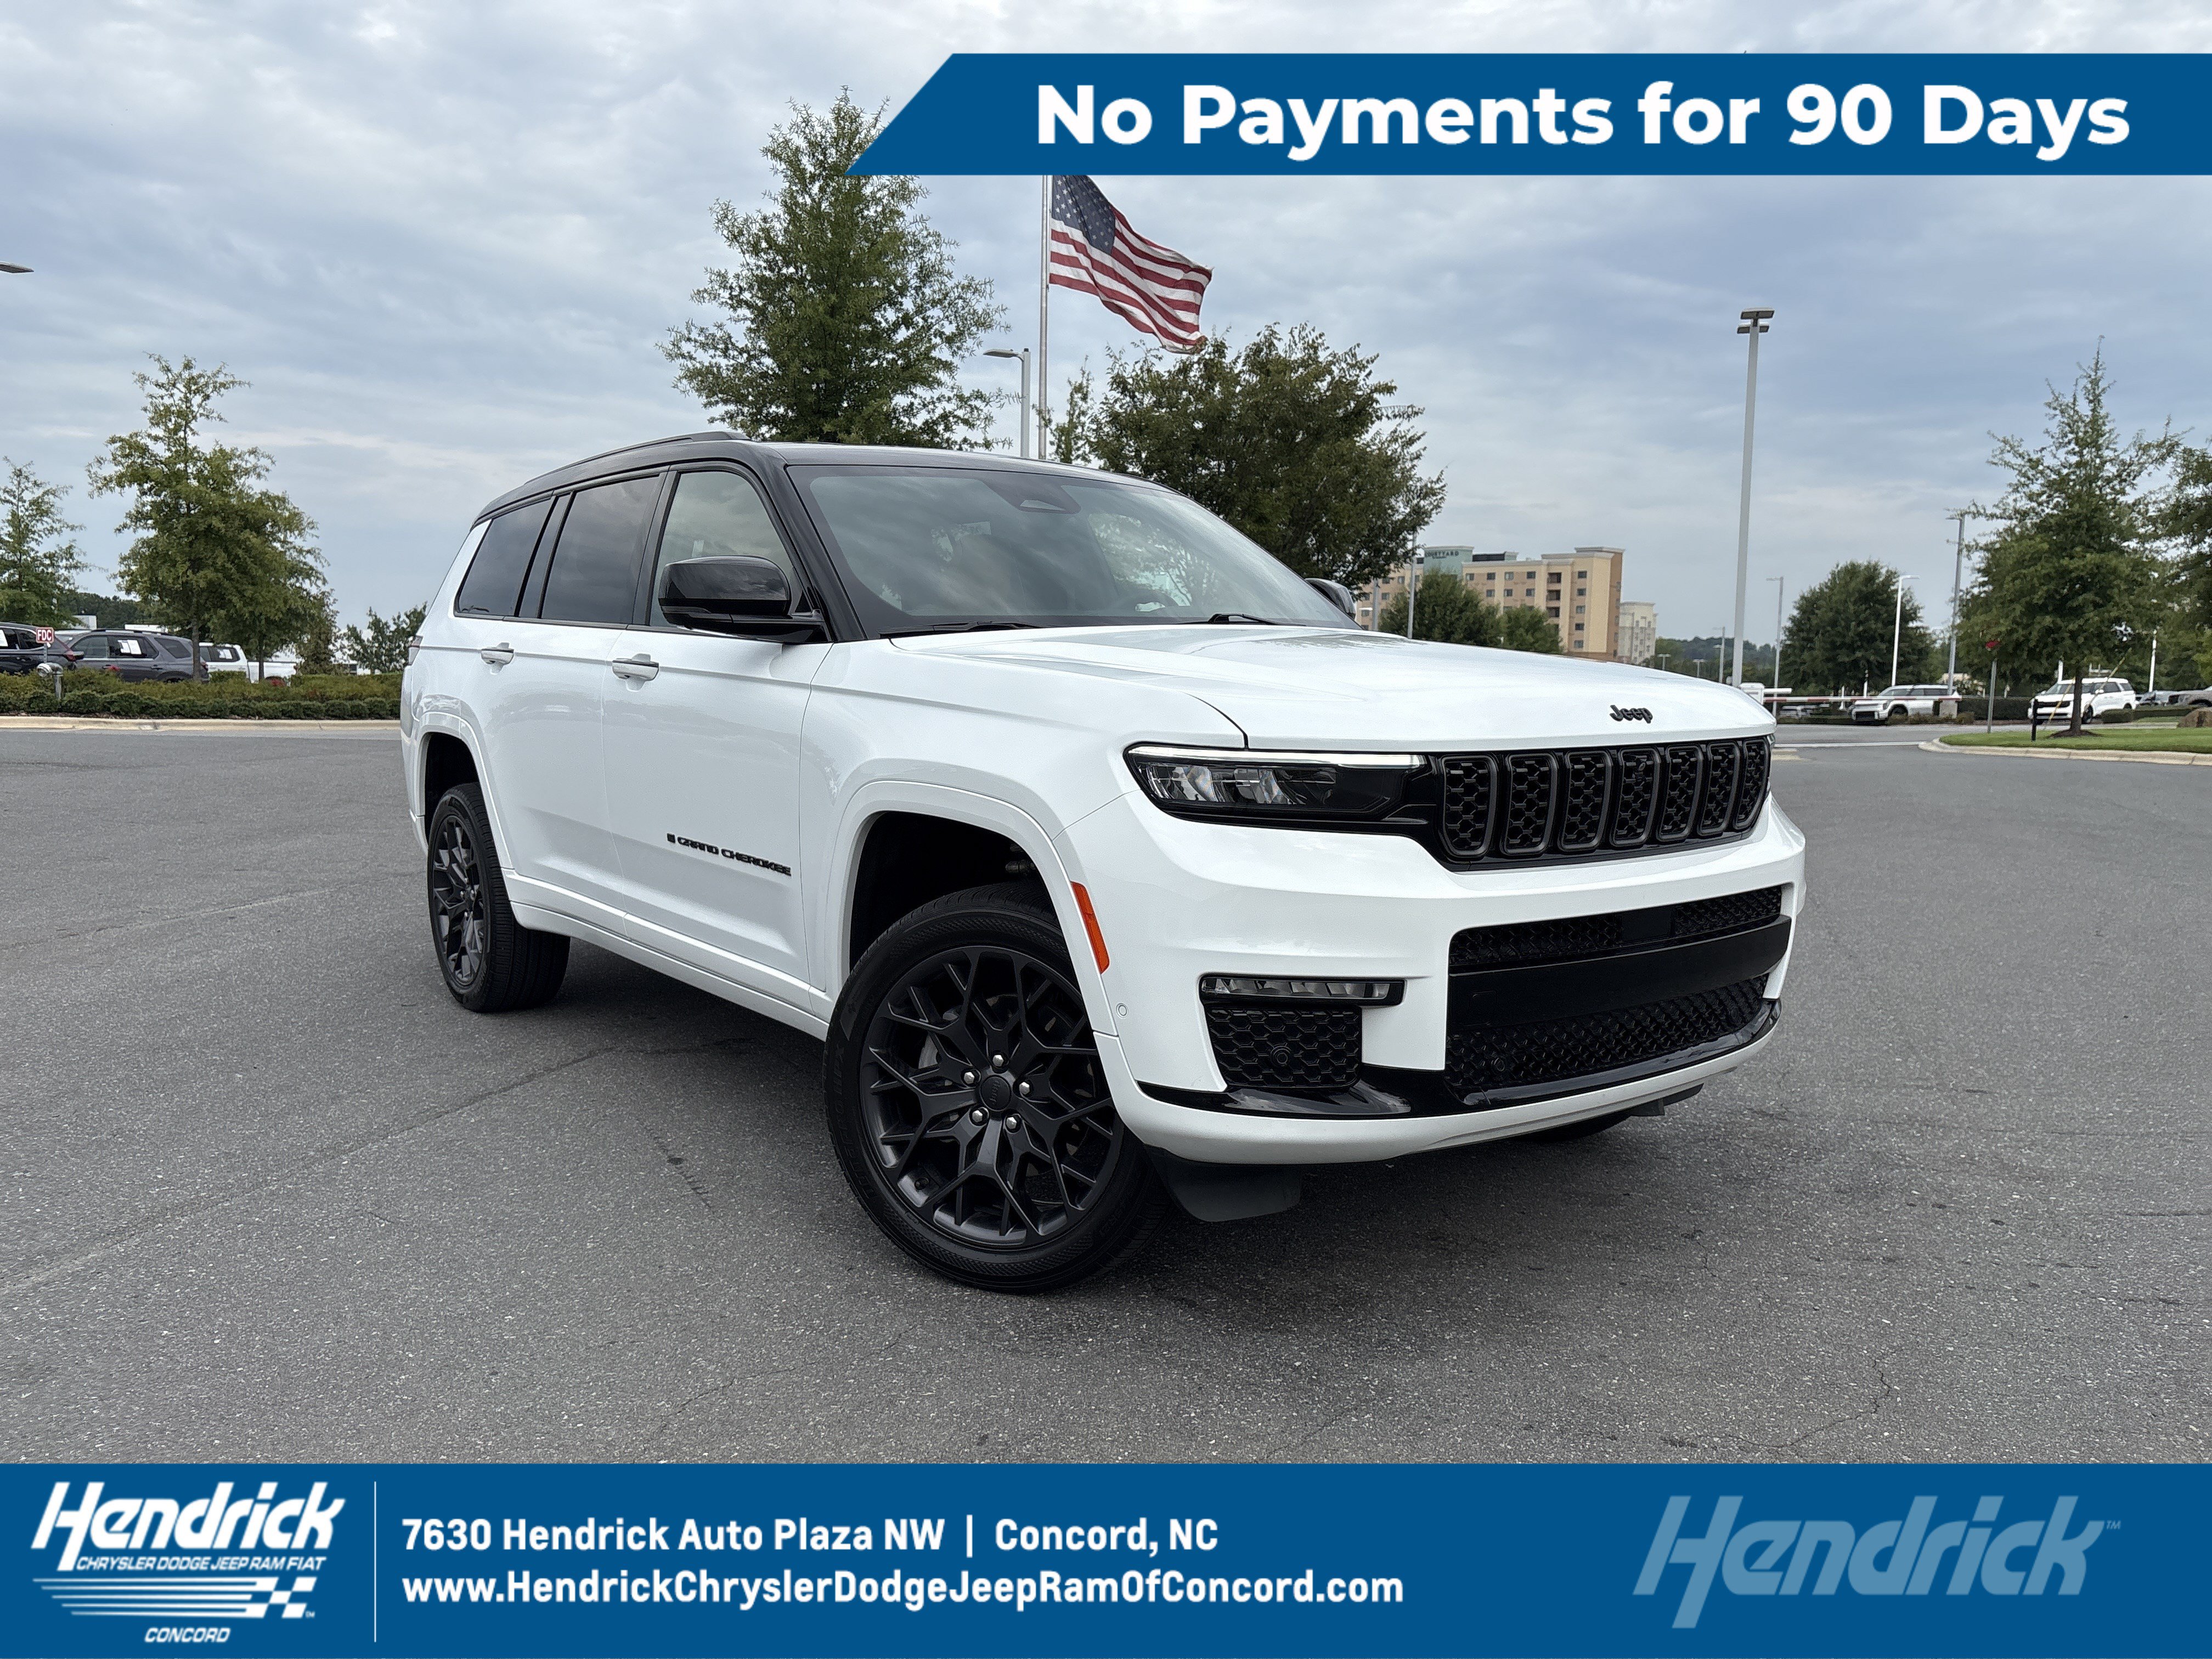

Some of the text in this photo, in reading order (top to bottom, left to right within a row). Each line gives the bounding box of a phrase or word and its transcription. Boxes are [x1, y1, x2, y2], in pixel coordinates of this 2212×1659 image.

[37, 629, 52, 641] FDC
[1609, 704, 1653, 724] Jeep
[677, 836, 792, 877] GRAND CHEROKEE
